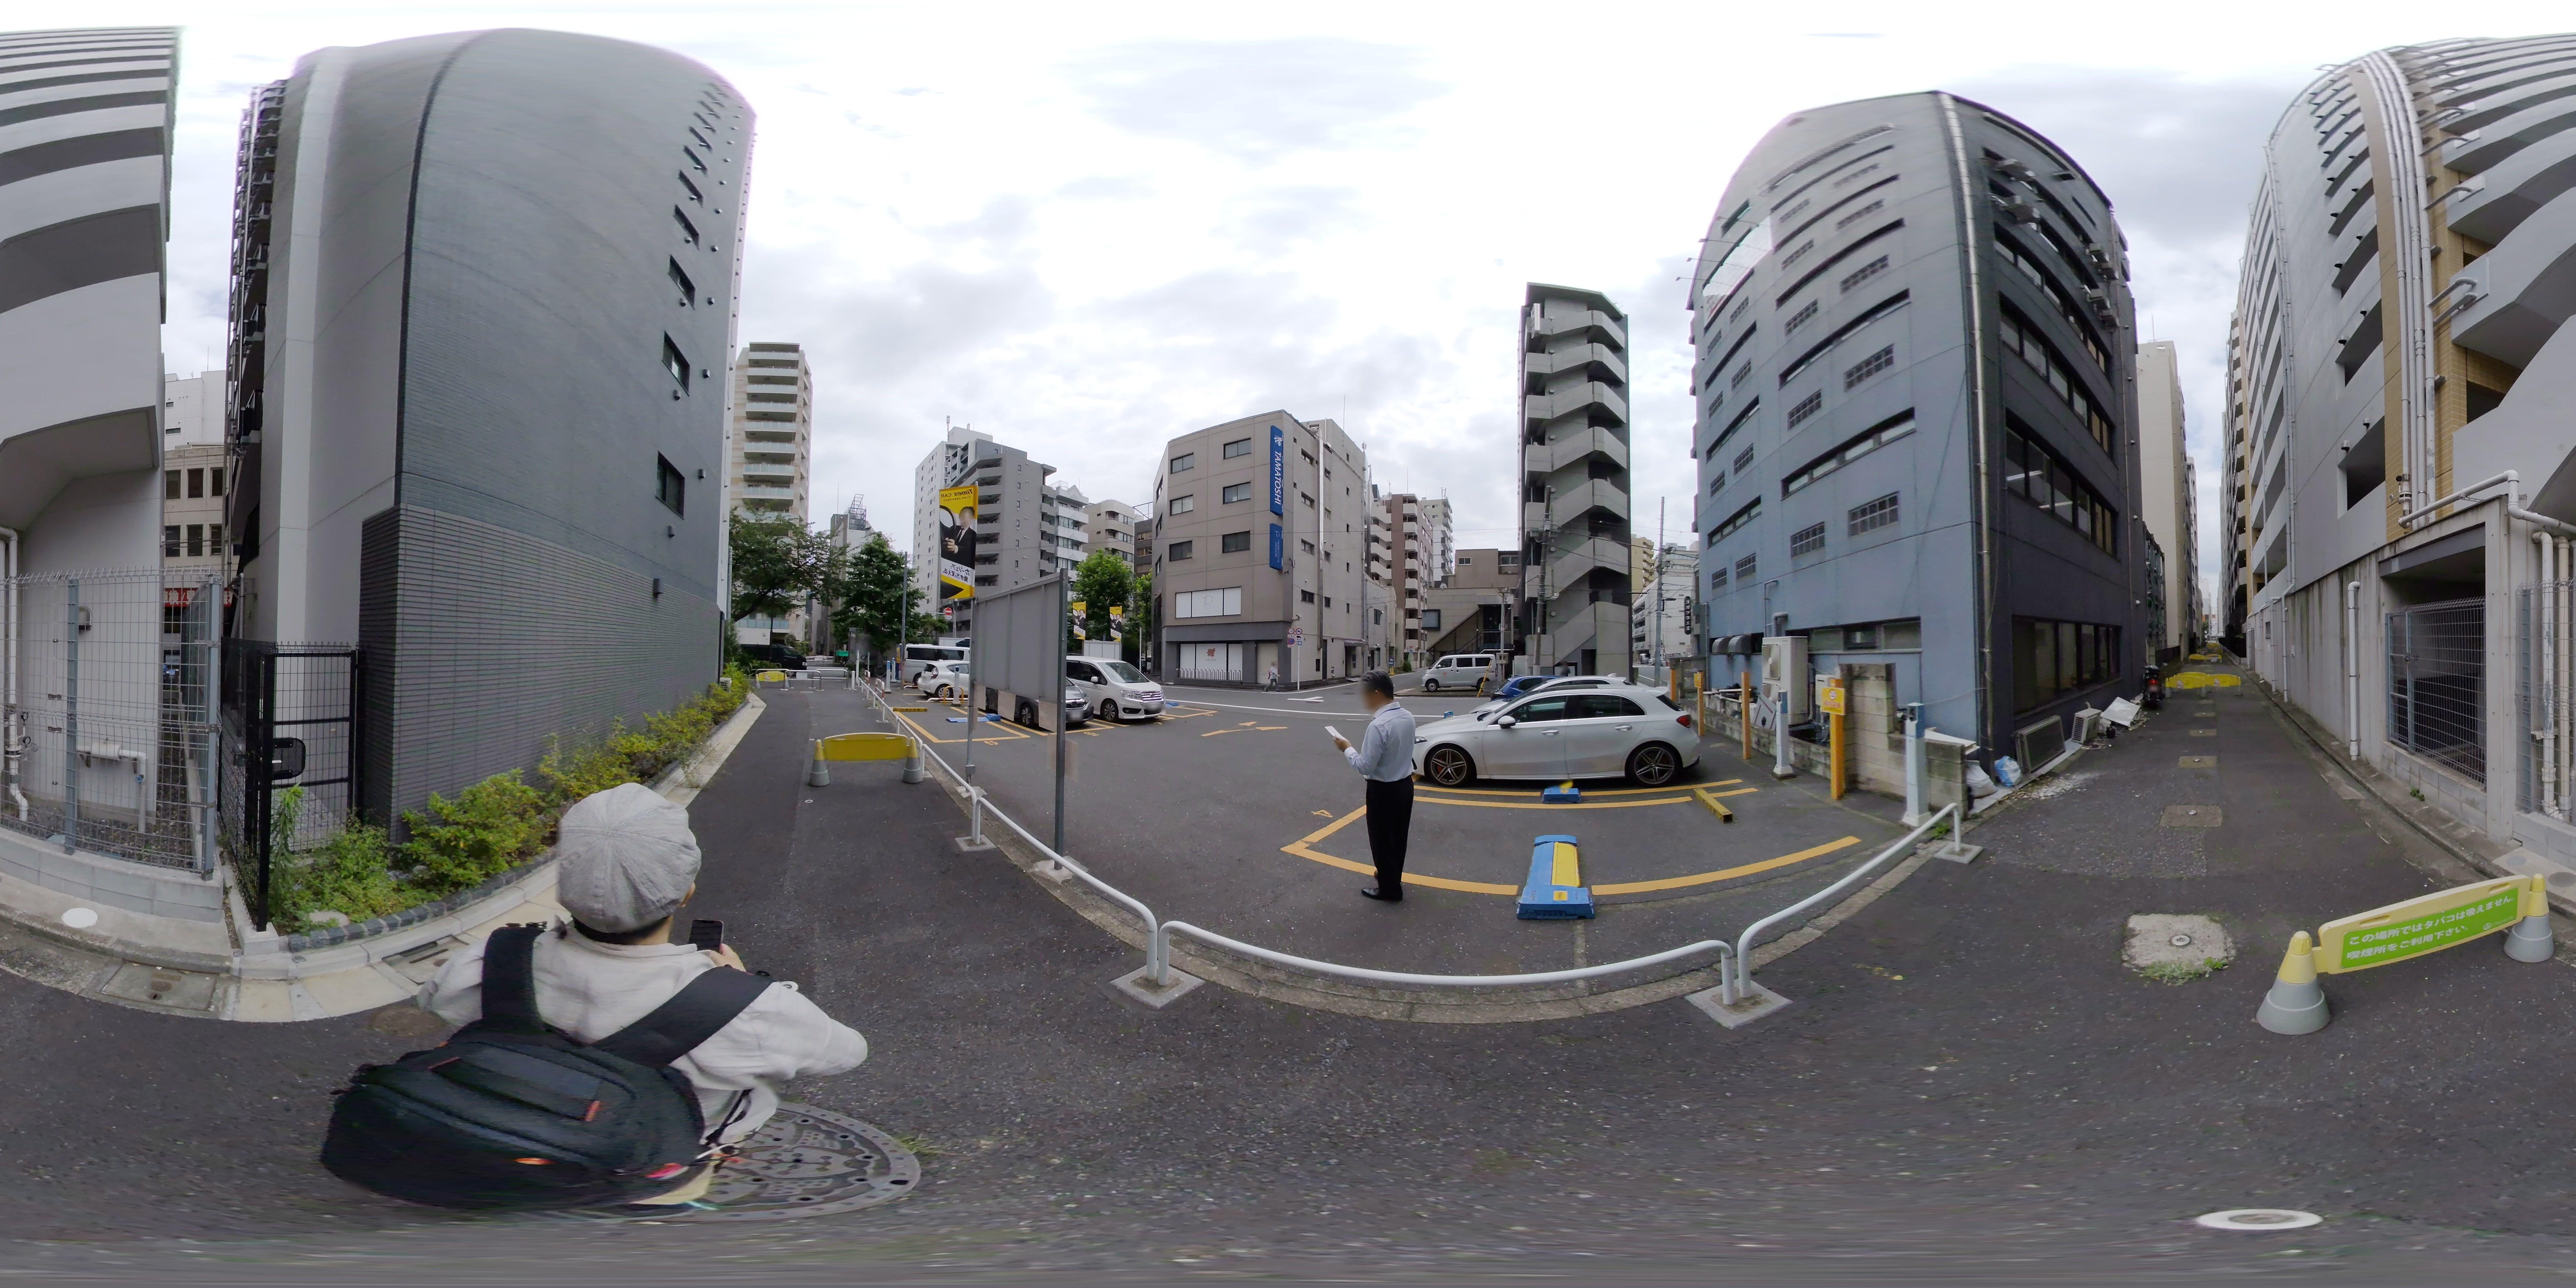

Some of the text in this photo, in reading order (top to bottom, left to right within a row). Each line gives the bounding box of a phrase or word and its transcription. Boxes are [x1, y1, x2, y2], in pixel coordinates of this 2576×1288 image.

[2349, 896, 2514, 945] この場所ではタバコは吸えません。
[2347, 926, 2468, 959] 喫煙所をご利用下さい。
